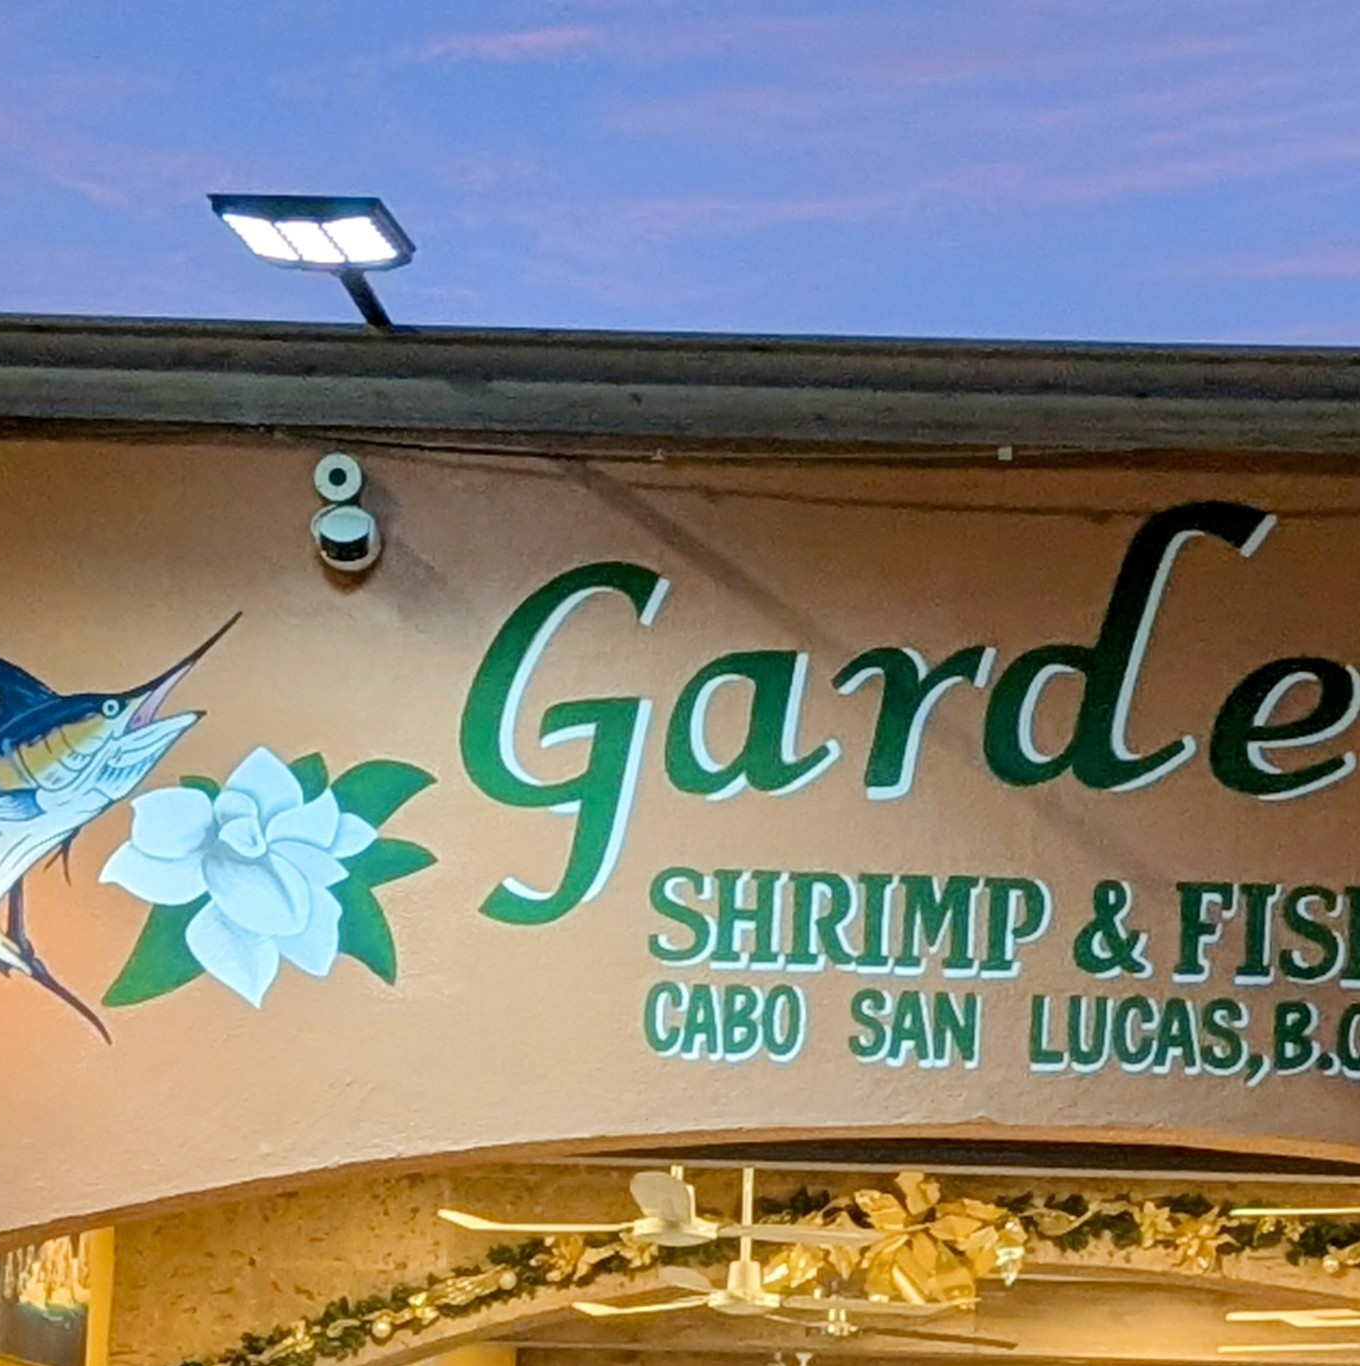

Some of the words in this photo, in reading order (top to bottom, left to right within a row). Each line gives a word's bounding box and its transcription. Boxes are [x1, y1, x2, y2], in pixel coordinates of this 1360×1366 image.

[647, 866, 1051, 978] SHRIMP
[1072, 880, 1153, 978] &
[644, 981, 804, 1063] CABO
[848, 988, 978, 1069] SAN
